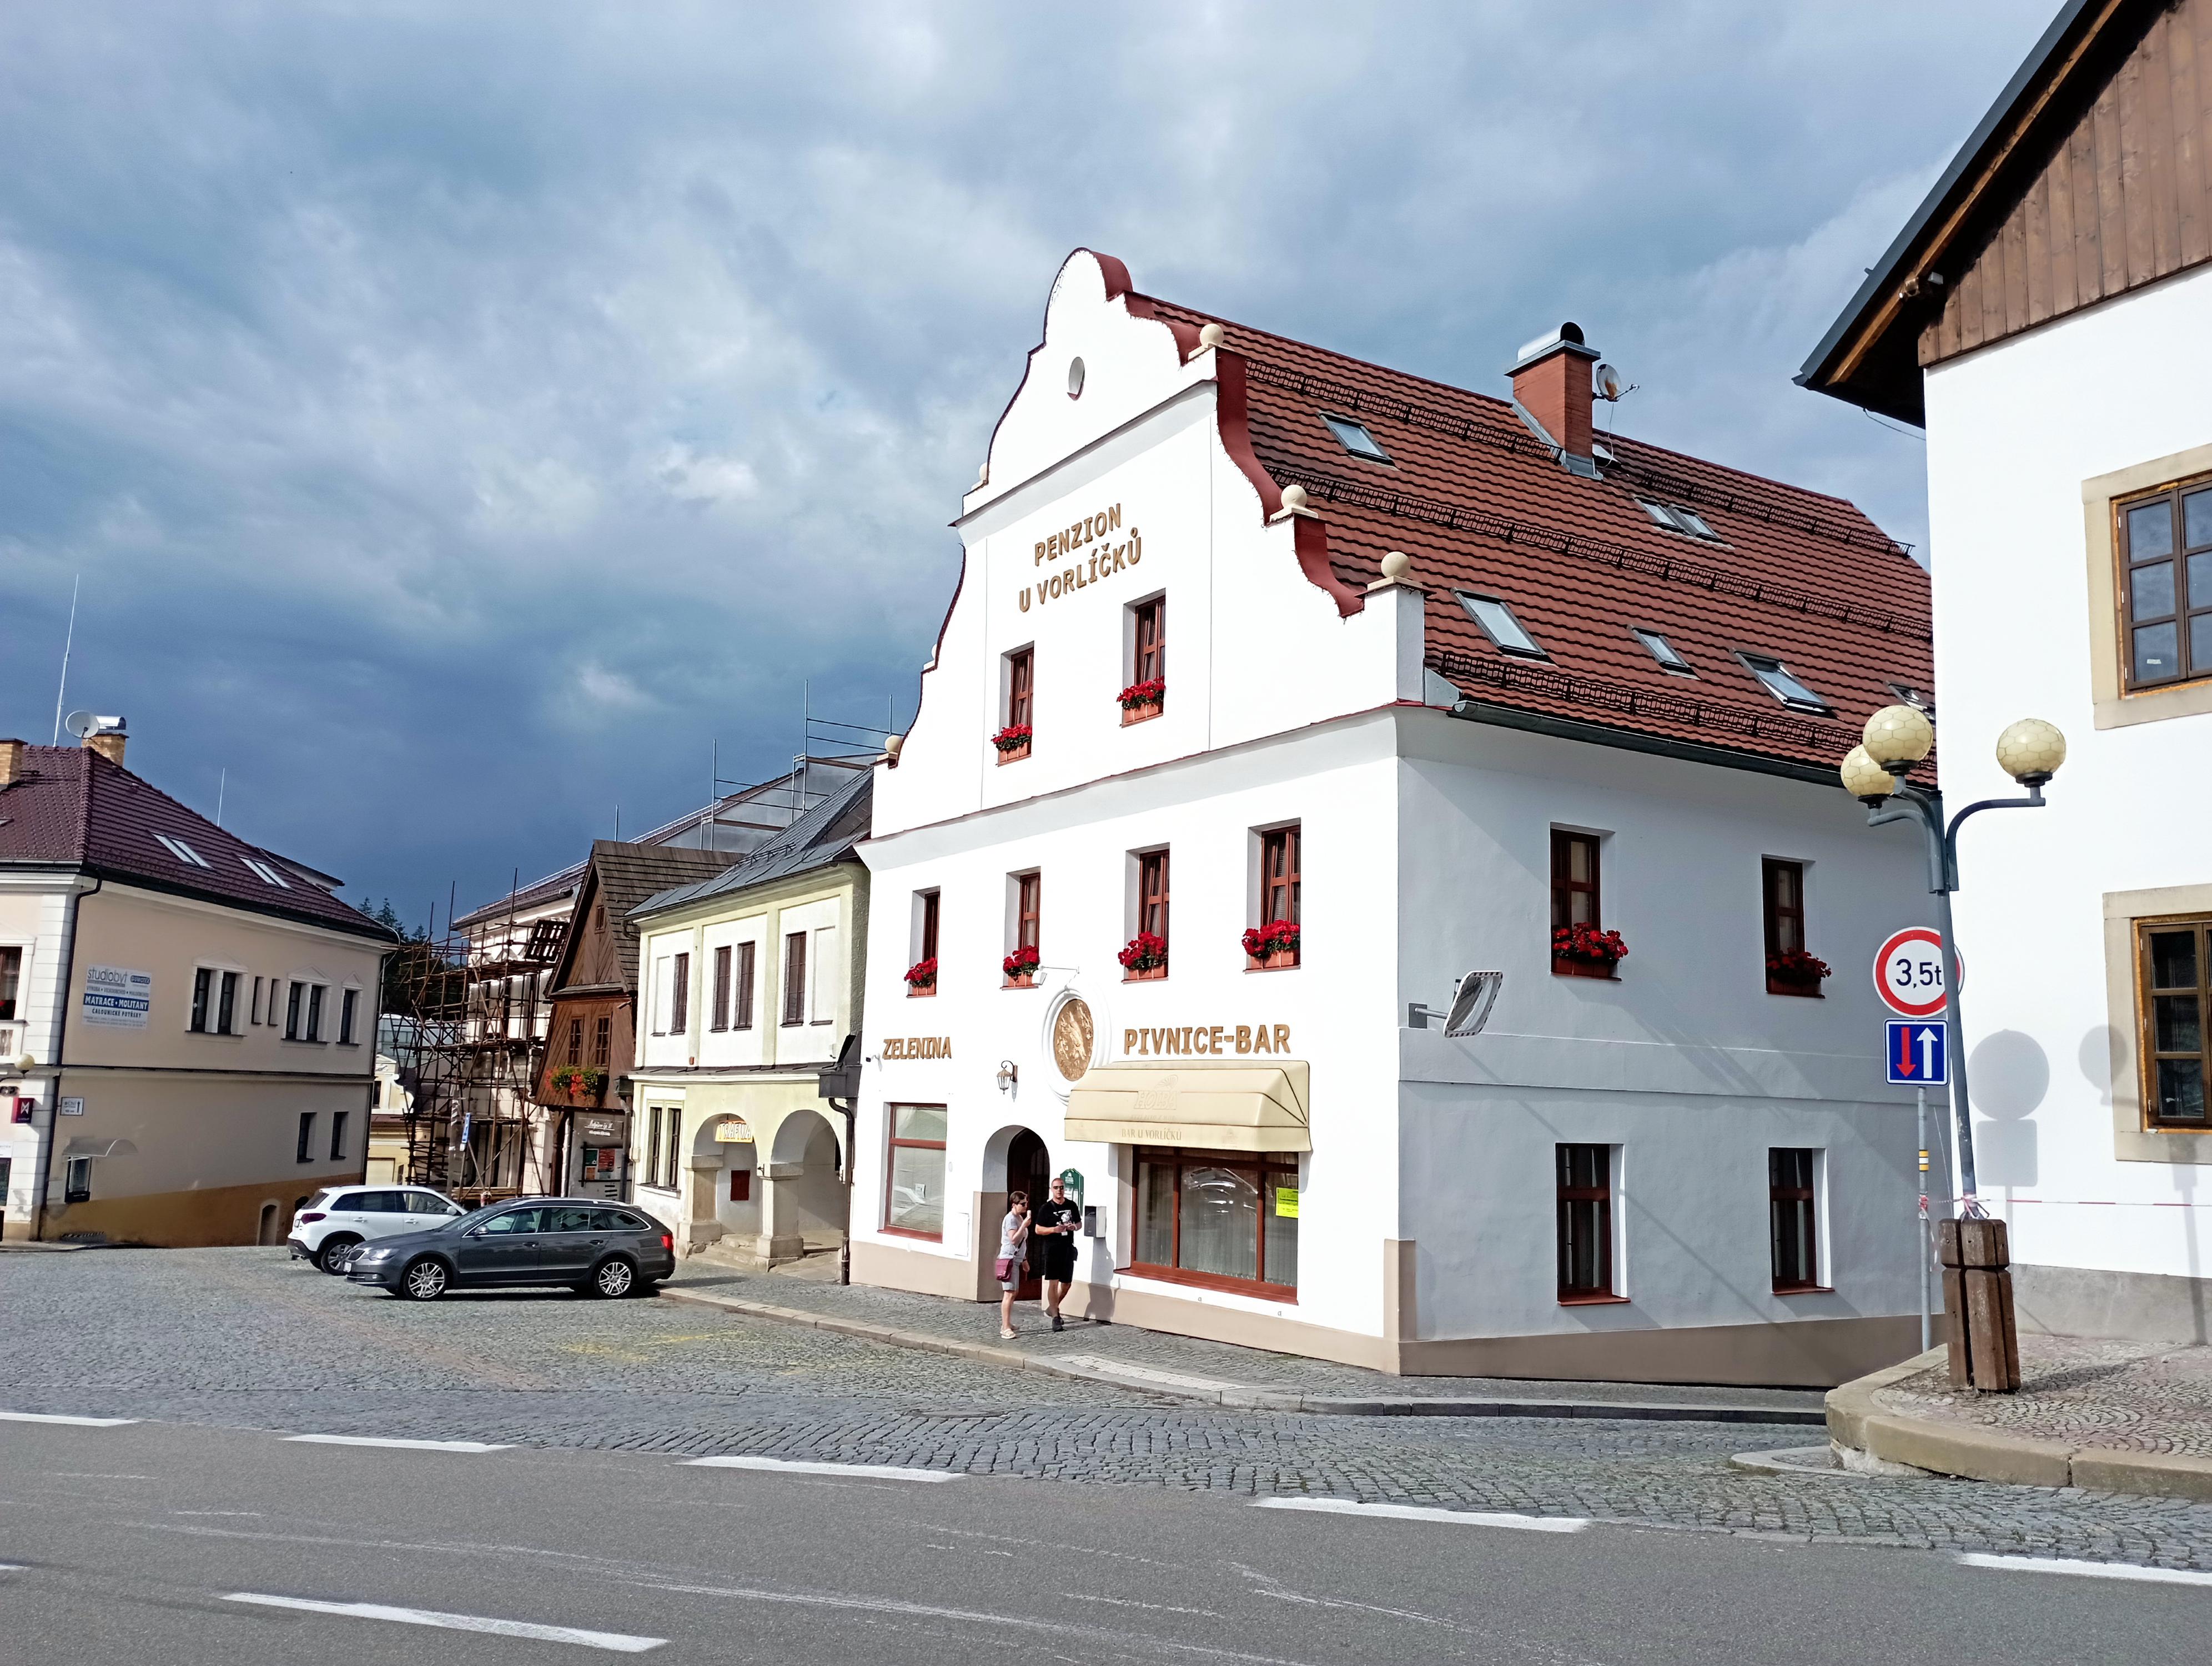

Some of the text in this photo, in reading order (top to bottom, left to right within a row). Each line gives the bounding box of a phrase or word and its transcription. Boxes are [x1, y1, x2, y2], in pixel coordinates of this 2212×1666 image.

[1035, 503, 1120, 567] PENZION
[1019, 527, 1142, 613] U VORLÍČKŮ
[88, 967, 127, 983] studiobyt
[1896, 959, 1942, 988] 3,5t
[85, 996, 148, 1010] MATRACE MOLITANY
[882, 1037, 952, 1060] ZELENINA
[1124, 1024, 1291, 1055] PIVNICE-BAR
[1133, 1090, 1178, 1110] HOLBA
[1122, 1128, 1135, 1138] BAR
[1145, 1127, 1182, 1141] VORLÍČKŮ
